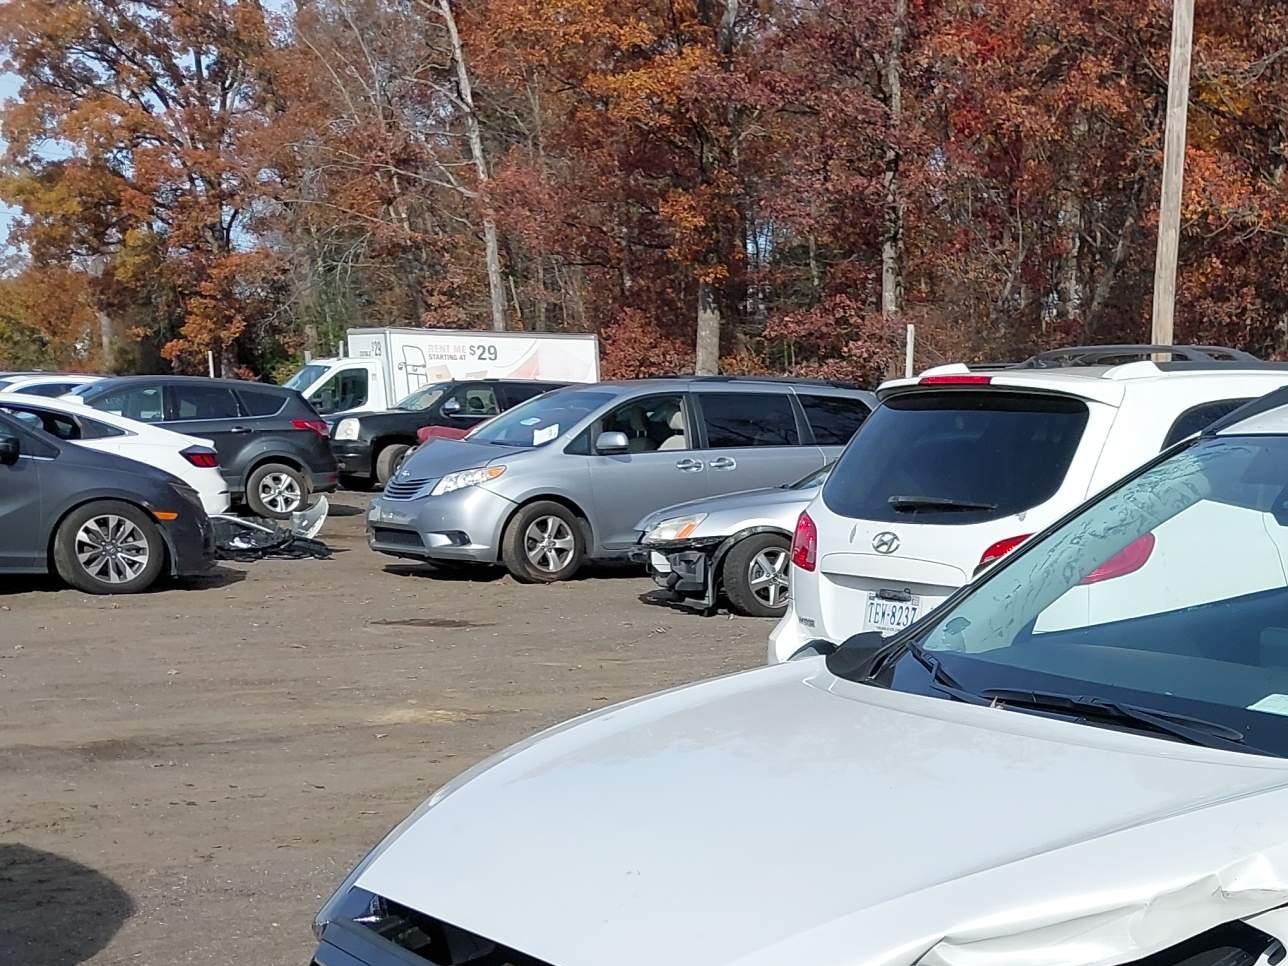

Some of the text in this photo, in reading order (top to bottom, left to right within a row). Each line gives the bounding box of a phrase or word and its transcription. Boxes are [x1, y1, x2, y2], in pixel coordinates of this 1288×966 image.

[428, 344, 498, 361] RENT ME $29
